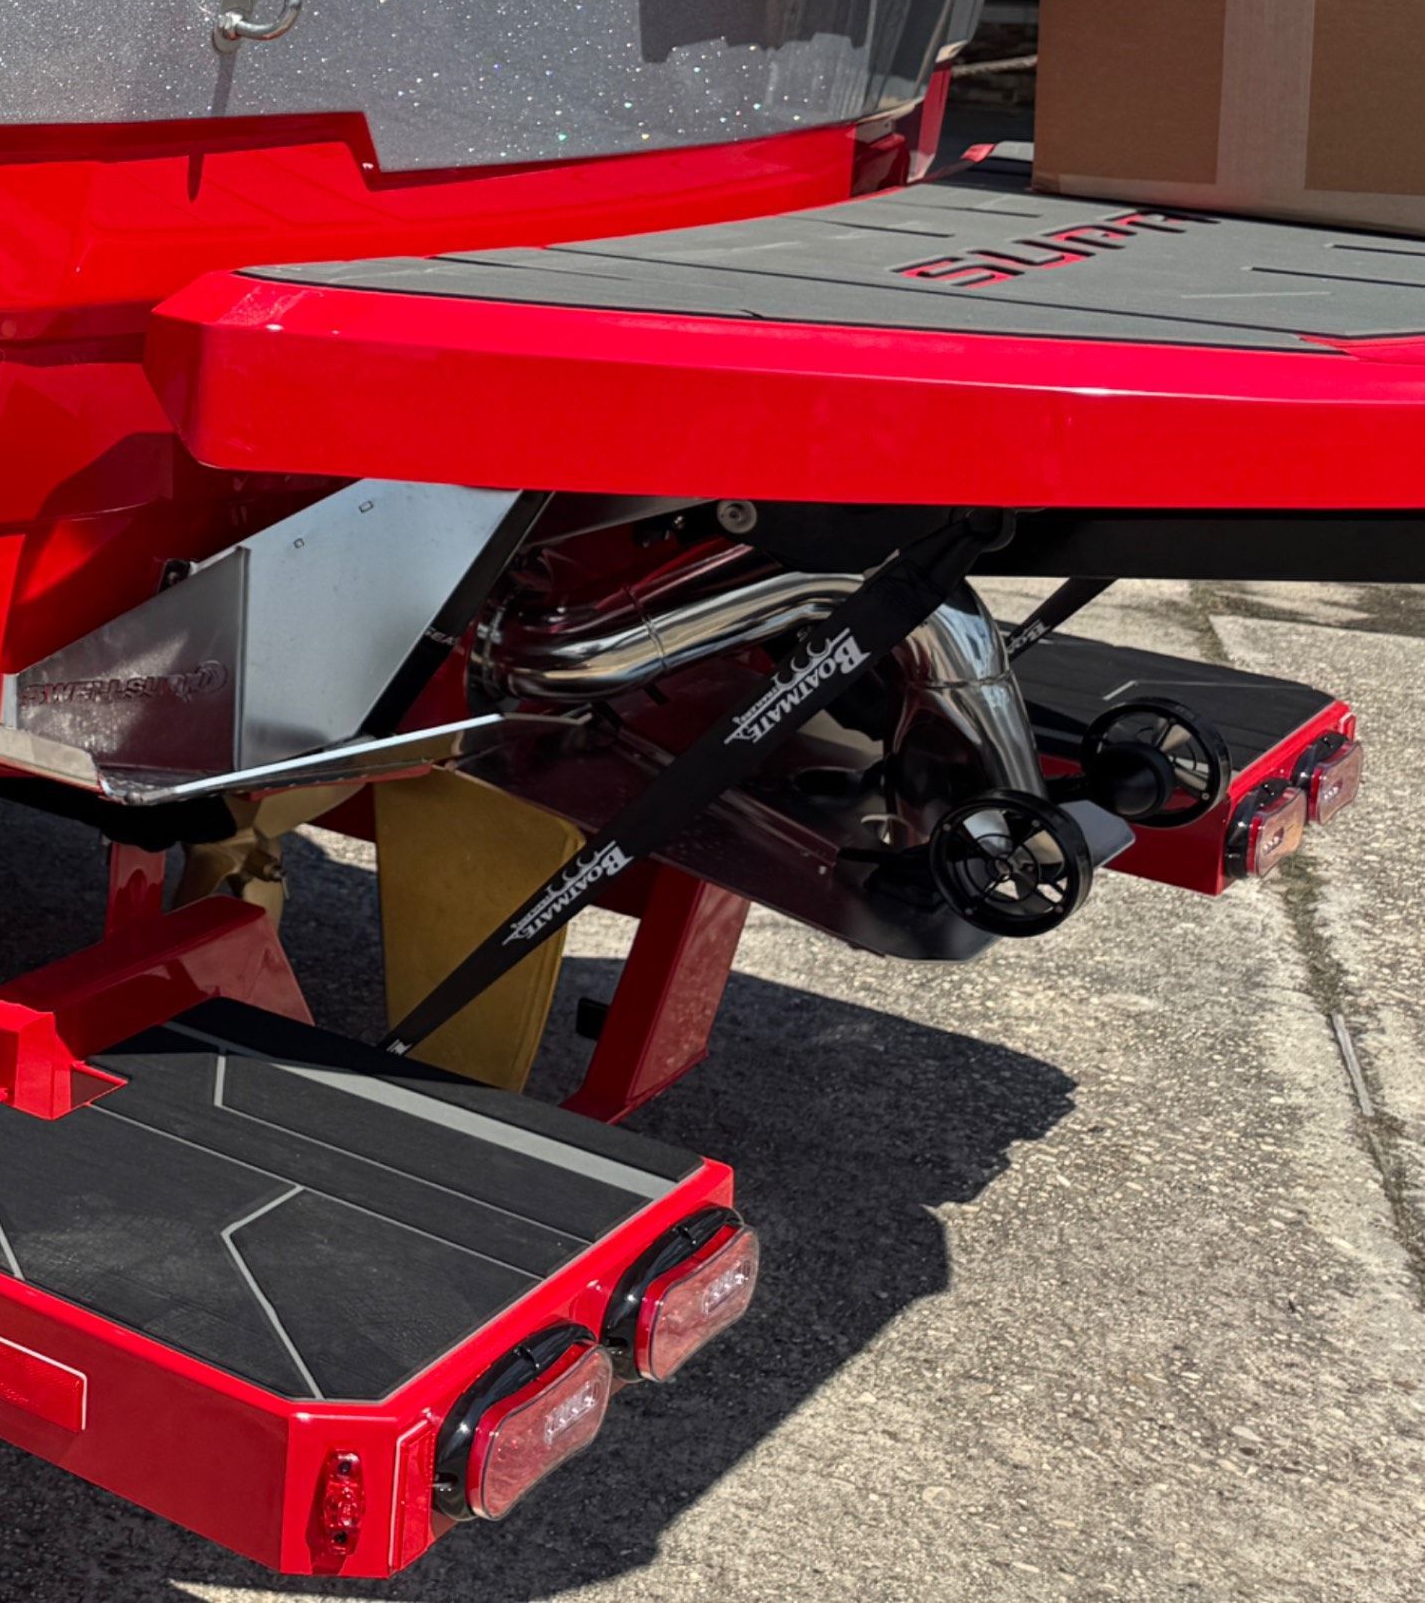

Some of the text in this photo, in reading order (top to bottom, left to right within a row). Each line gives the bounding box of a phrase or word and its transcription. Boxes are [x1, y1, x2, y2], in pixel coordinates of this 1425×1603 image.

[888, 207, 1221, 290] SUPR
[747, 635, 872, 743] BOATMATE
[521, 845, 634, 939] BOATMATE
